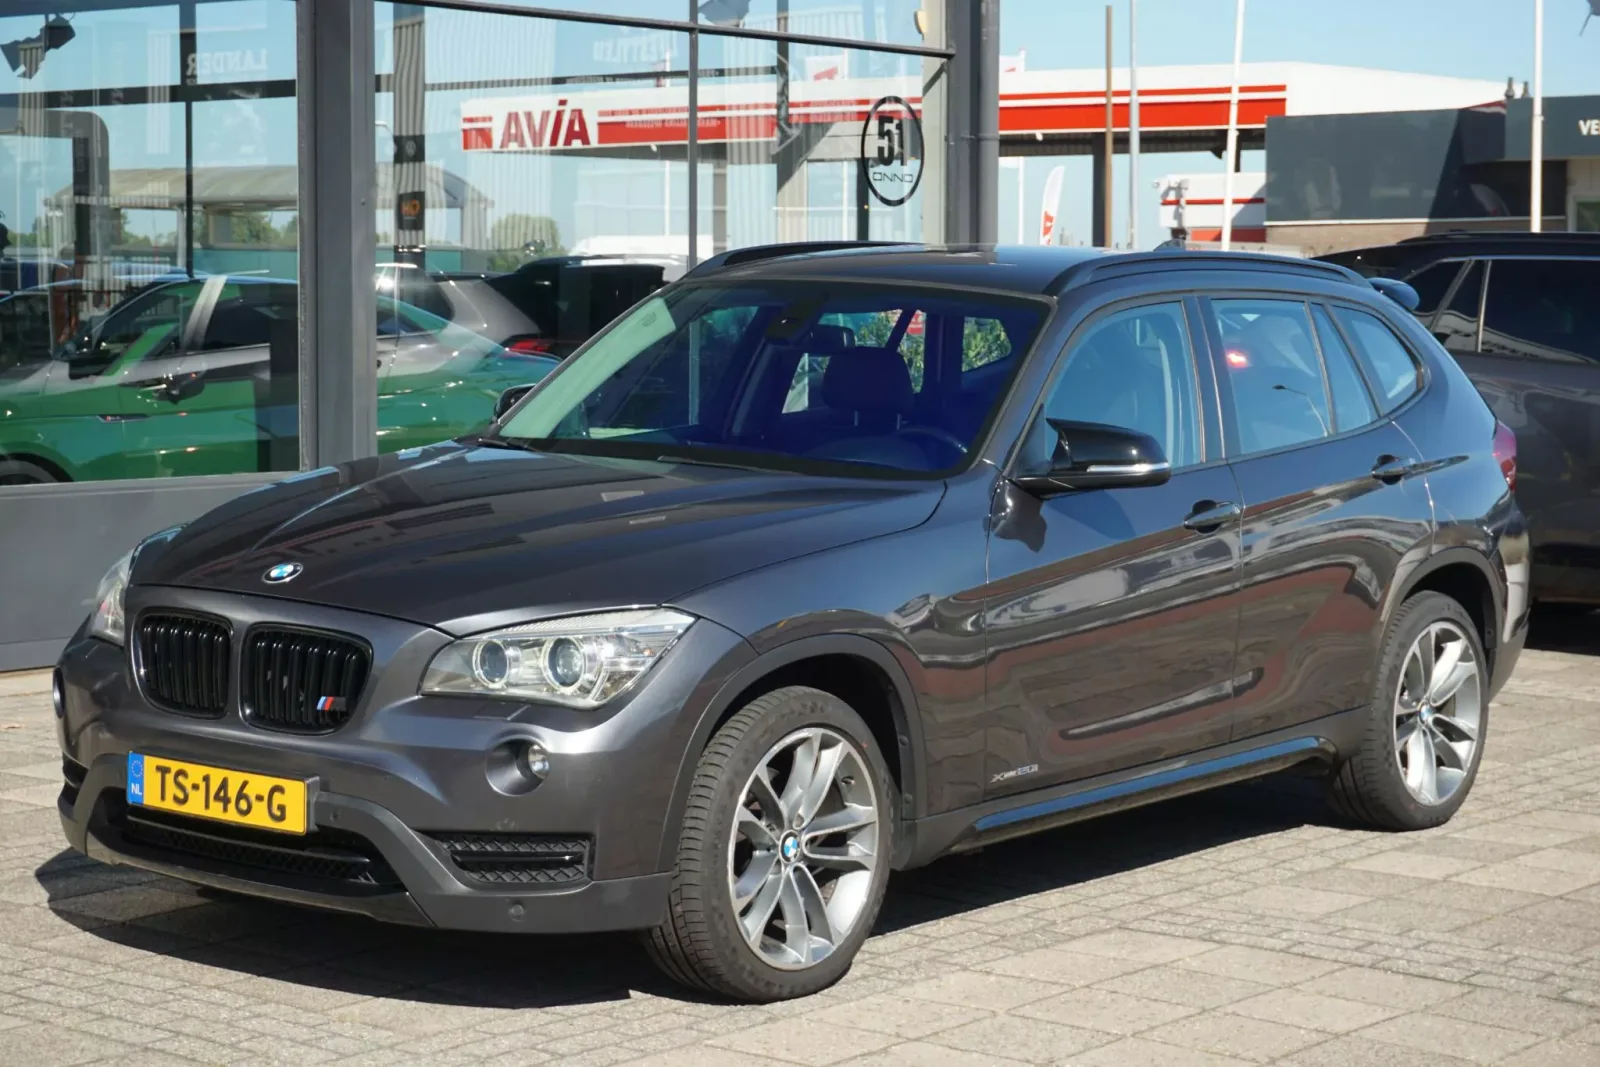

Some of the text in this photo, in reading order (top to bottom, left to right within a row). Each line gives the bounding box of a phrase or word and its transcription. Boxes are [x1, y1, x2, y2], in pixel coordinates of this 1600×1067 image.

[877, 115, 907, 166] 51
[872, 171, 914, 183] ONNO
[131, 782, 142, 796] NL
[155, 764, 287, 823] TS-146-G
